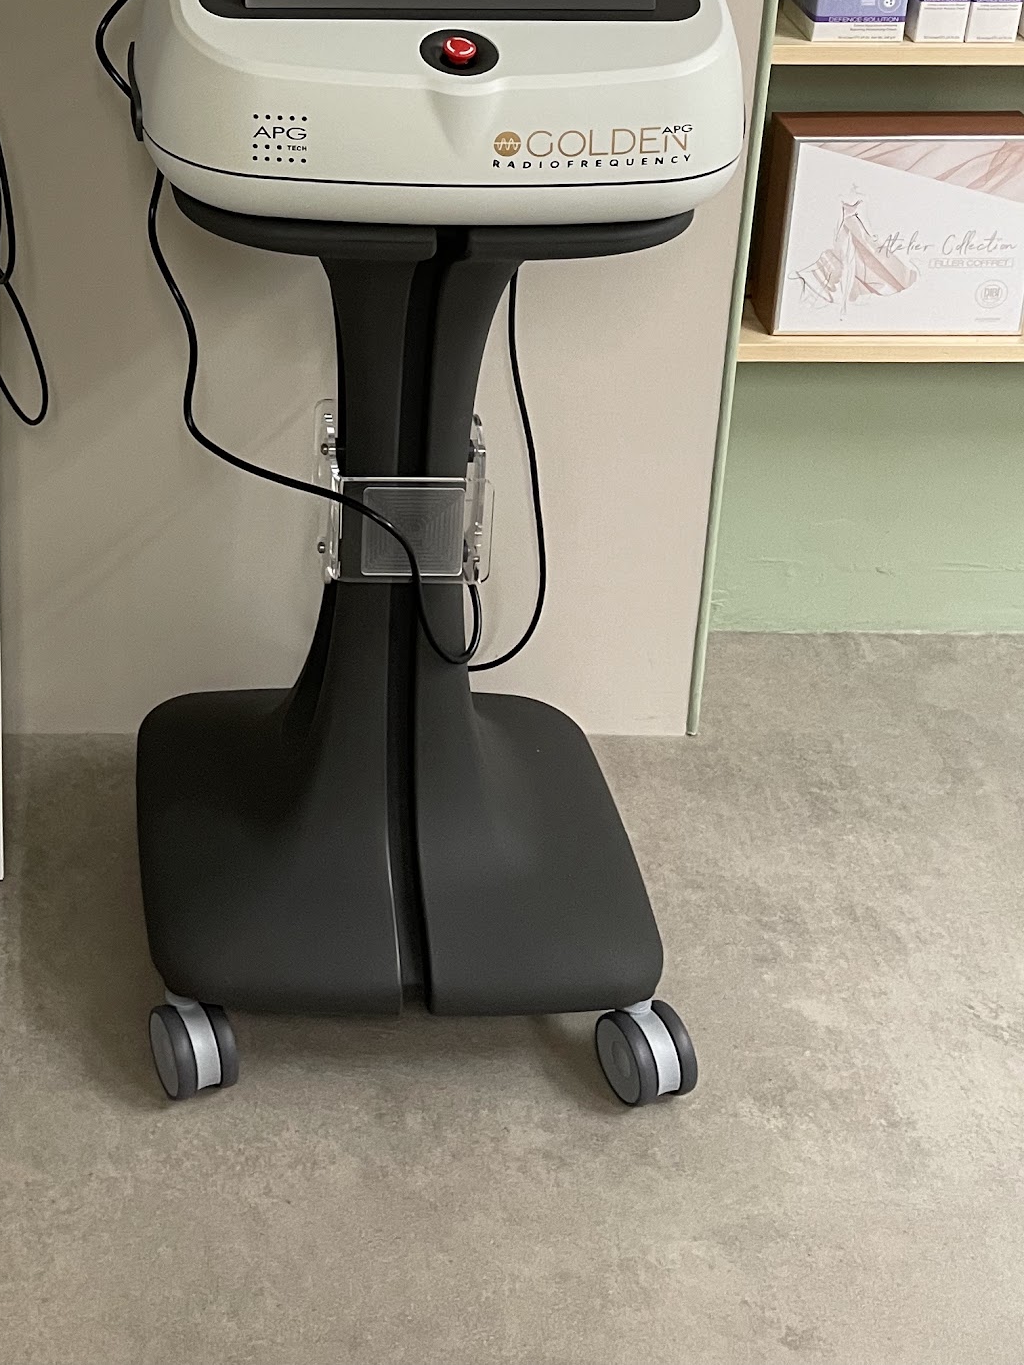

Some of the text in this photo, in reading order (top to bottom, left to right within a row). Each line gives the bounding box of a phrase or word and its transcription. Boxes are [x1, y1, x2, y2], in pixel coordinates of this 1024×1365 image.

[253, 125, 307, 141] APG
[526, 123, 694, 158] GOLDEN APG
[286, 144, 307, 152] TECH
[492, 153, 692, 169] RADIOFREQUENCY
[877, 230, 1018, 258] Atelier Collection
